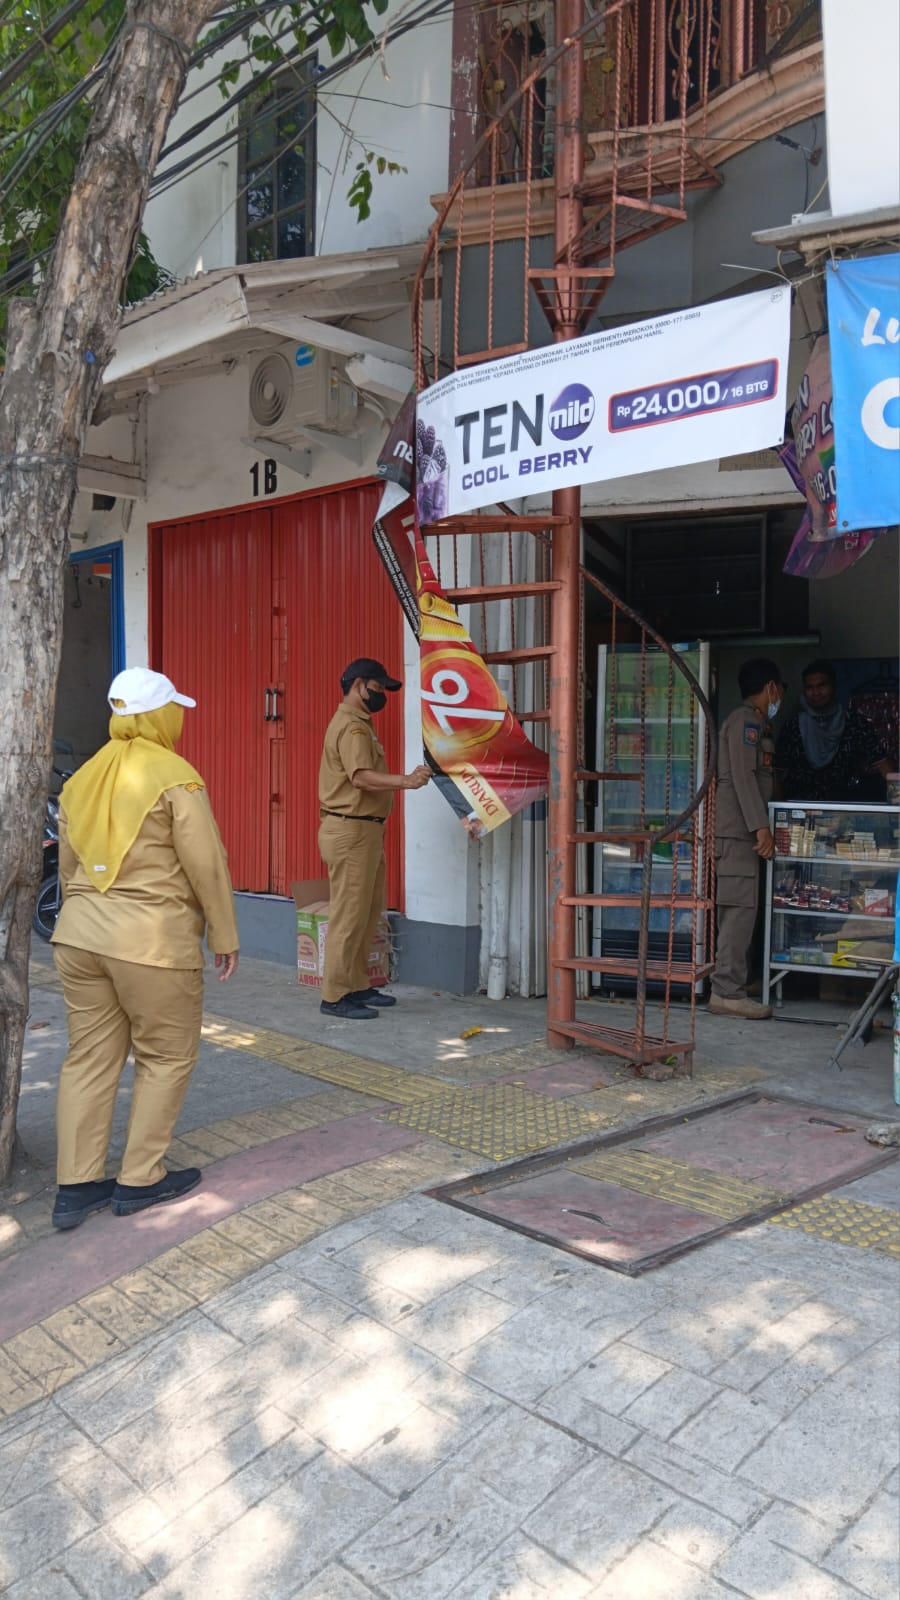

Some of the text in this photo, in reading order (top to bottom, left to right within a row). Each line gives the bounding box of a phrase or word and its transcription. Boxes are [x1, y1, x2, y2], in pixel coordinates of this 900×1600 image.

[746, 380, 768, 394] BTG
[454, 393, 595, 465] TEN mild
[462, 446, 593, 491] COOL BERRY
